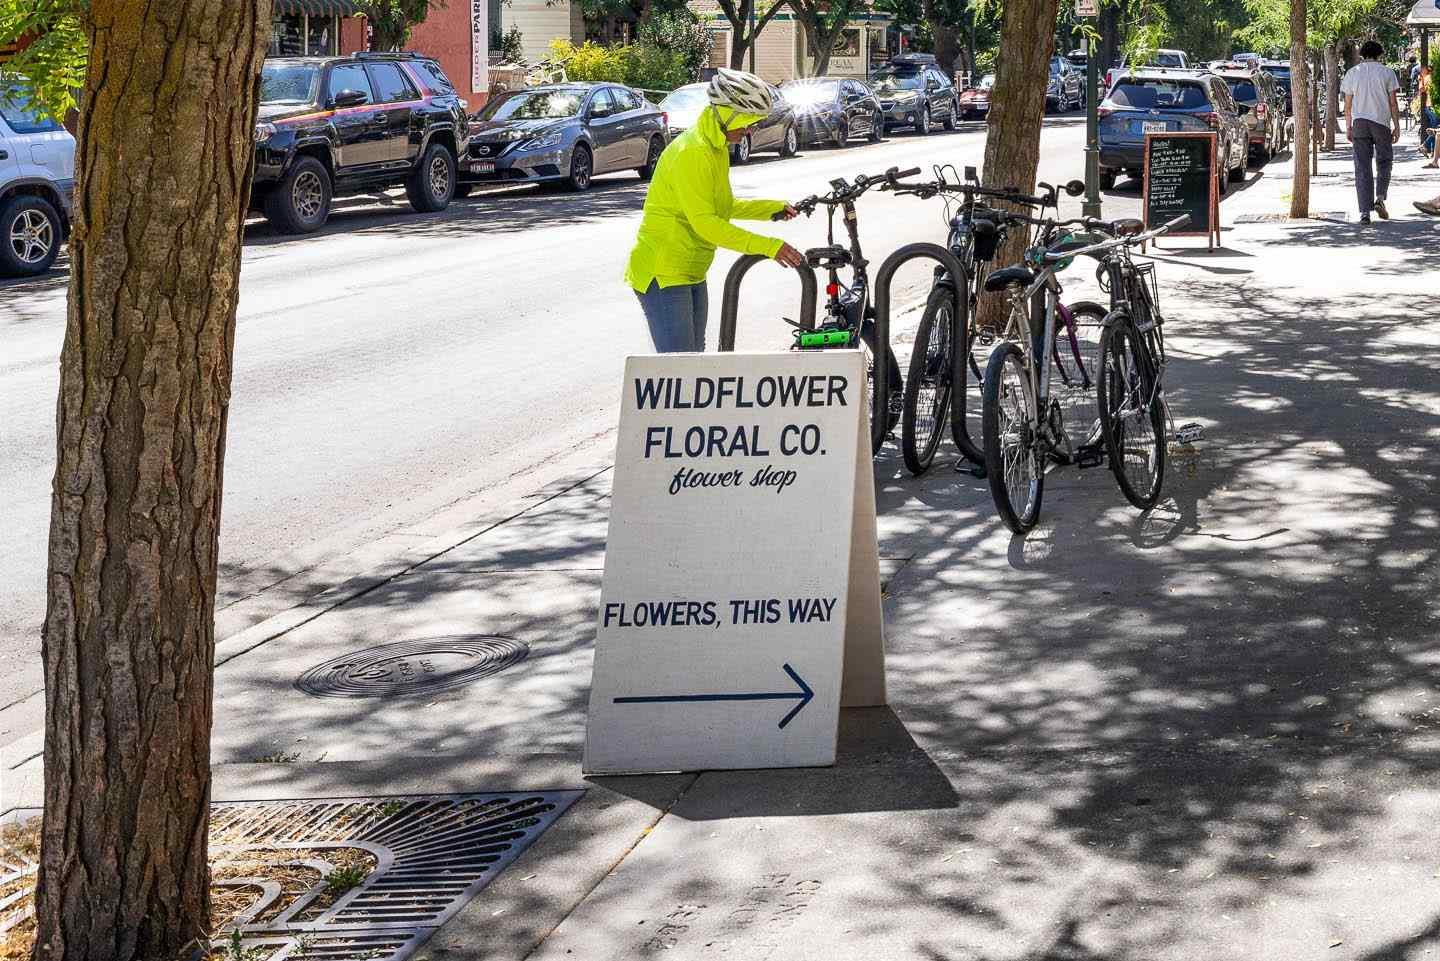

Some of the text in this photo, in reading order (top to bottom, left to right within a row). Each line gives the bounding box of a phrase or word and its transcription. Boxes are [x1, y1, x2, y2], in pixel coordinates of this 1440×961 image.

[634, 375, 849, 410] WILDFLOWER
[644, 423, 827, 458] FLORAL CO.
[668, 464, 797, 495] flower shop
[603, 597, 838, 629] FLOWERS, THIS WAY
